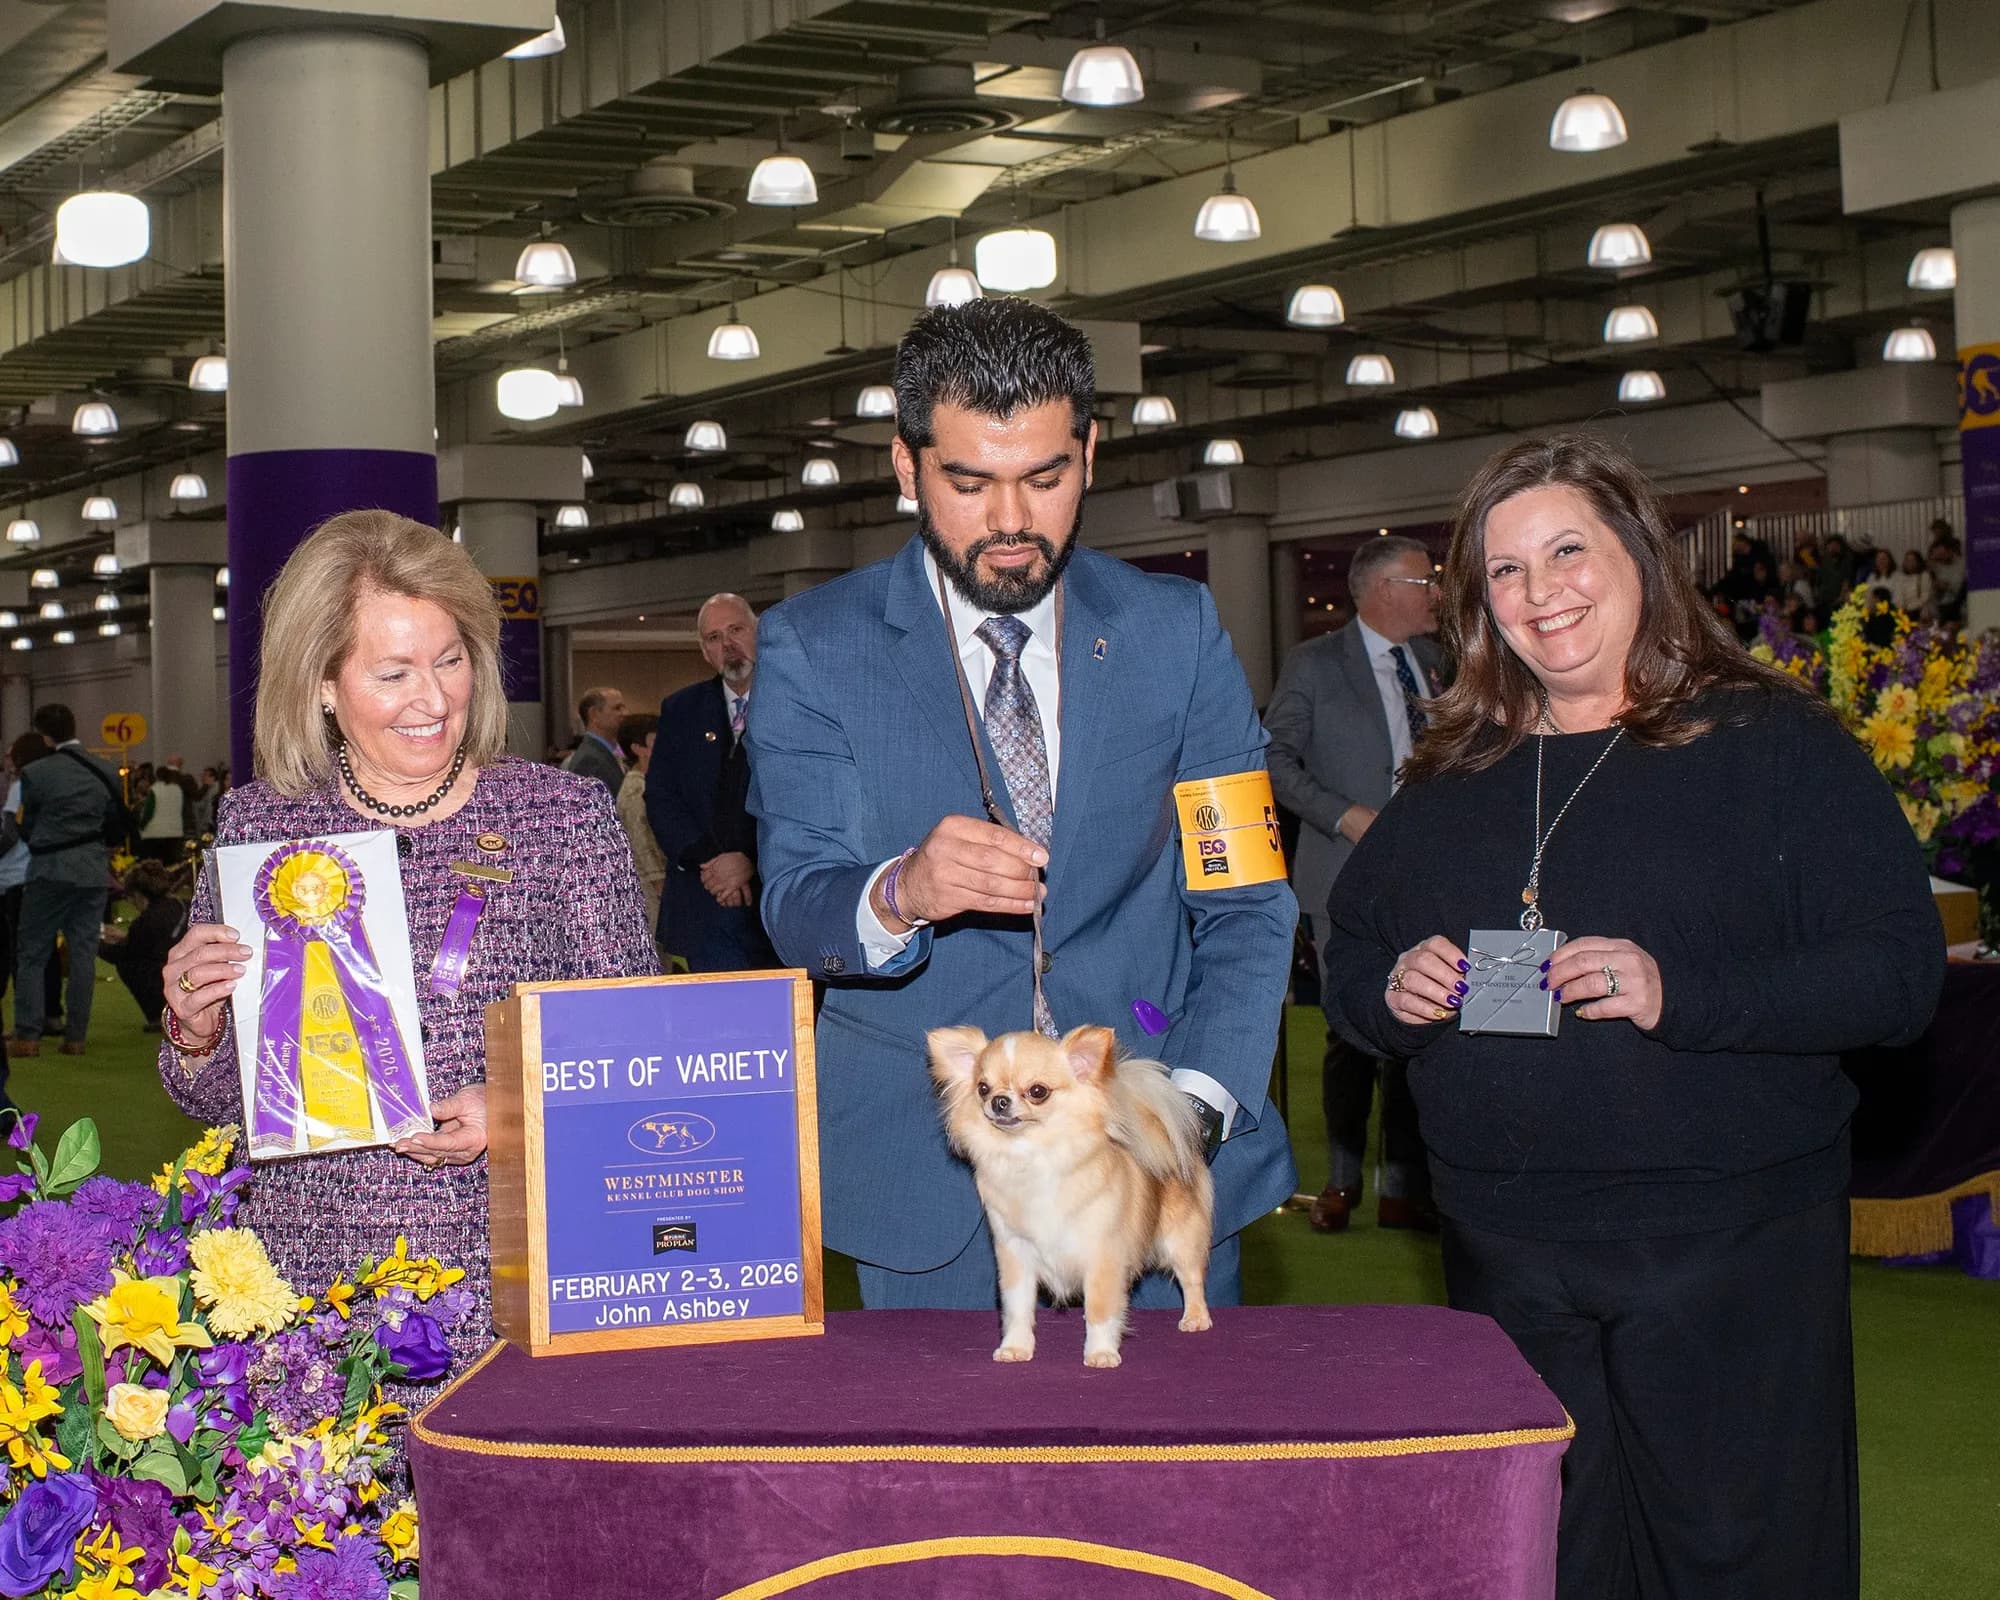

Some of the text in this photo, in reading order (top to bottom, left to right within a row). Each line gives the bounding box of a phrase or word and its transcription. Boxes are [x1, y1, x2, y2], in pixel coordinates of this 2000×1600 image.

[117, 716, 132, 742] 6
[1196, 805, 1220, 831] AKC
[1198, 838, 1227, 856] 150
[374, 1038, 399, 1076] 2026
[542, 1049, 788, 1092] BEST OF VARIETY
[260, 1080, 272, 1090] of
[604, 1169, 744, 1191] WESTMINSTER
[607, 1185, 745, 1202] KENNEL CLUB DOG SHOW
[552, 1263, 799, 1301] FEBRUARY 2-3, 2026
[595, 1297, 750, 1326] John Ashbey
